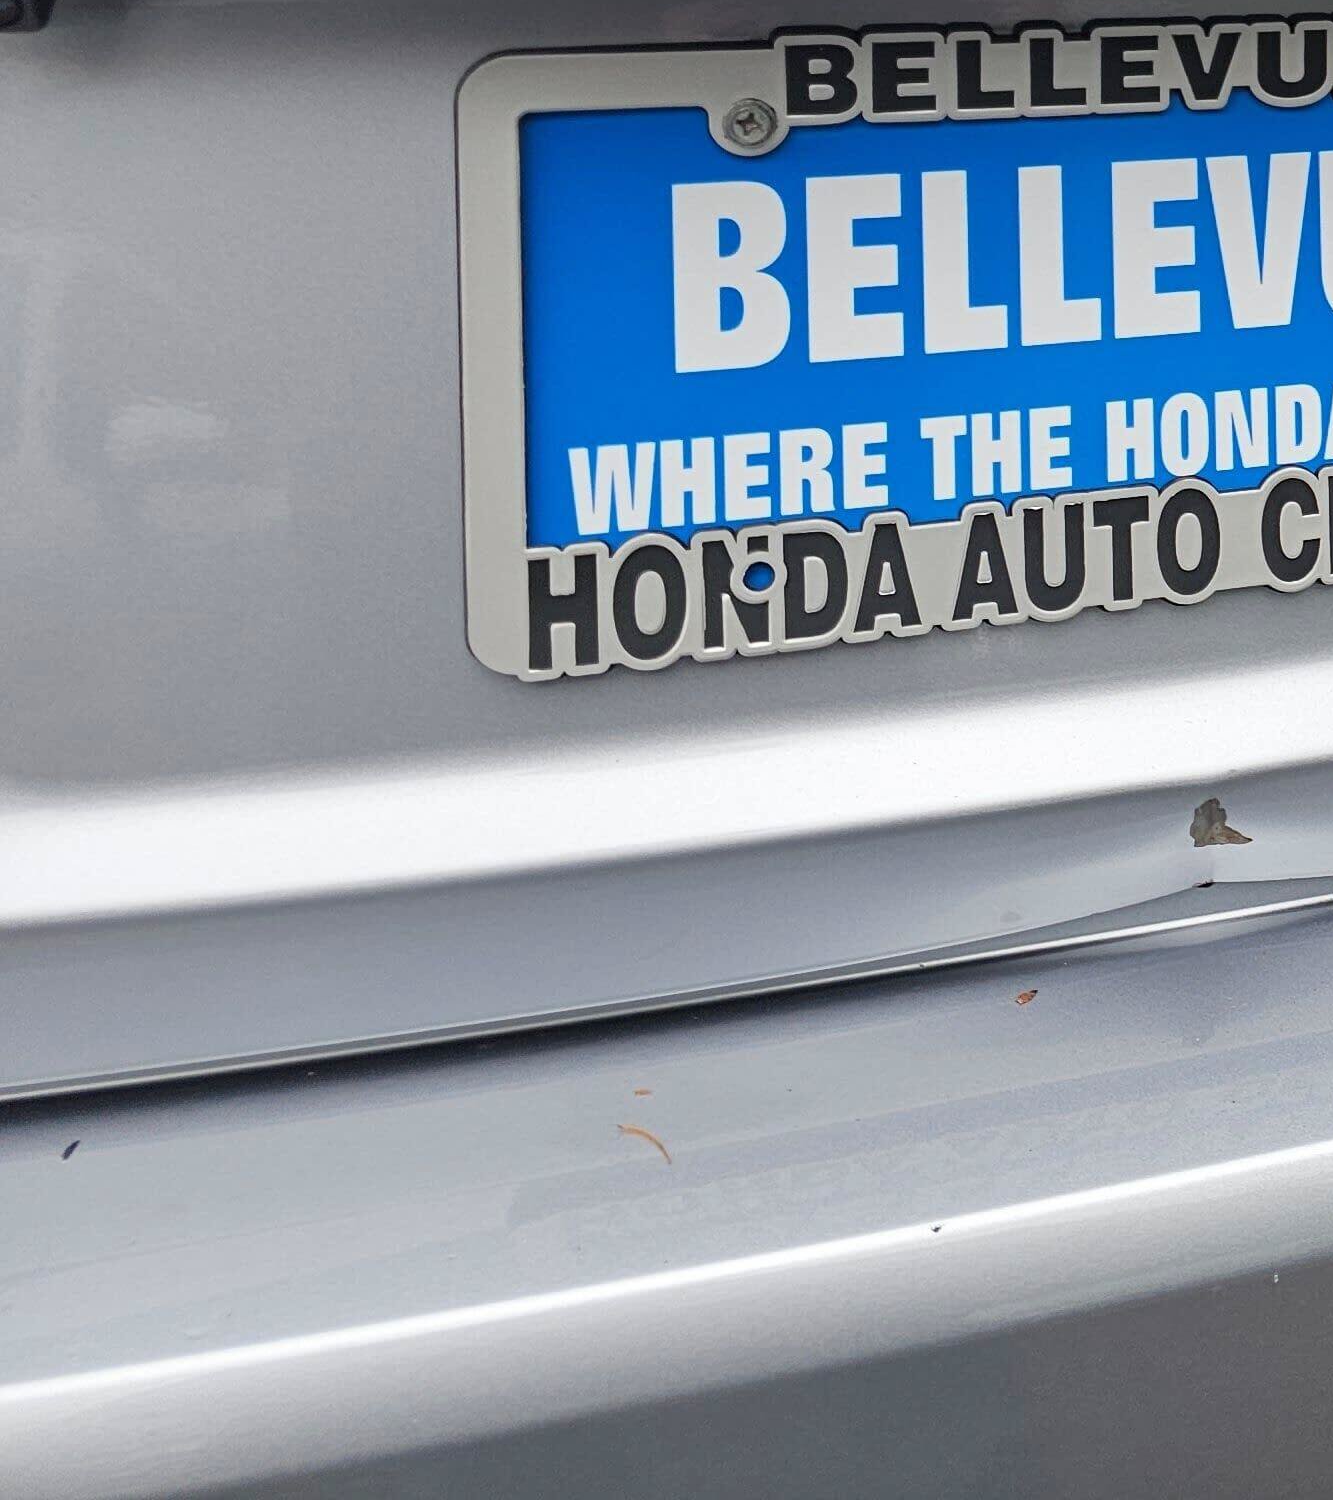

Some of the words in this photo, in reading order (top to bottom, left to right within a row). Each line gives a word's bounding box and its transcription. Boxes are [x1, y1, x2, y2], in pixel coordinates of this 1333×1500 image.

[568, 421, 889, 536] WHERE
[920, 404, 1073, 501] THE
[527, 522, 922, 672] HONDA
[951, 488, 1221, 621] AUTO
